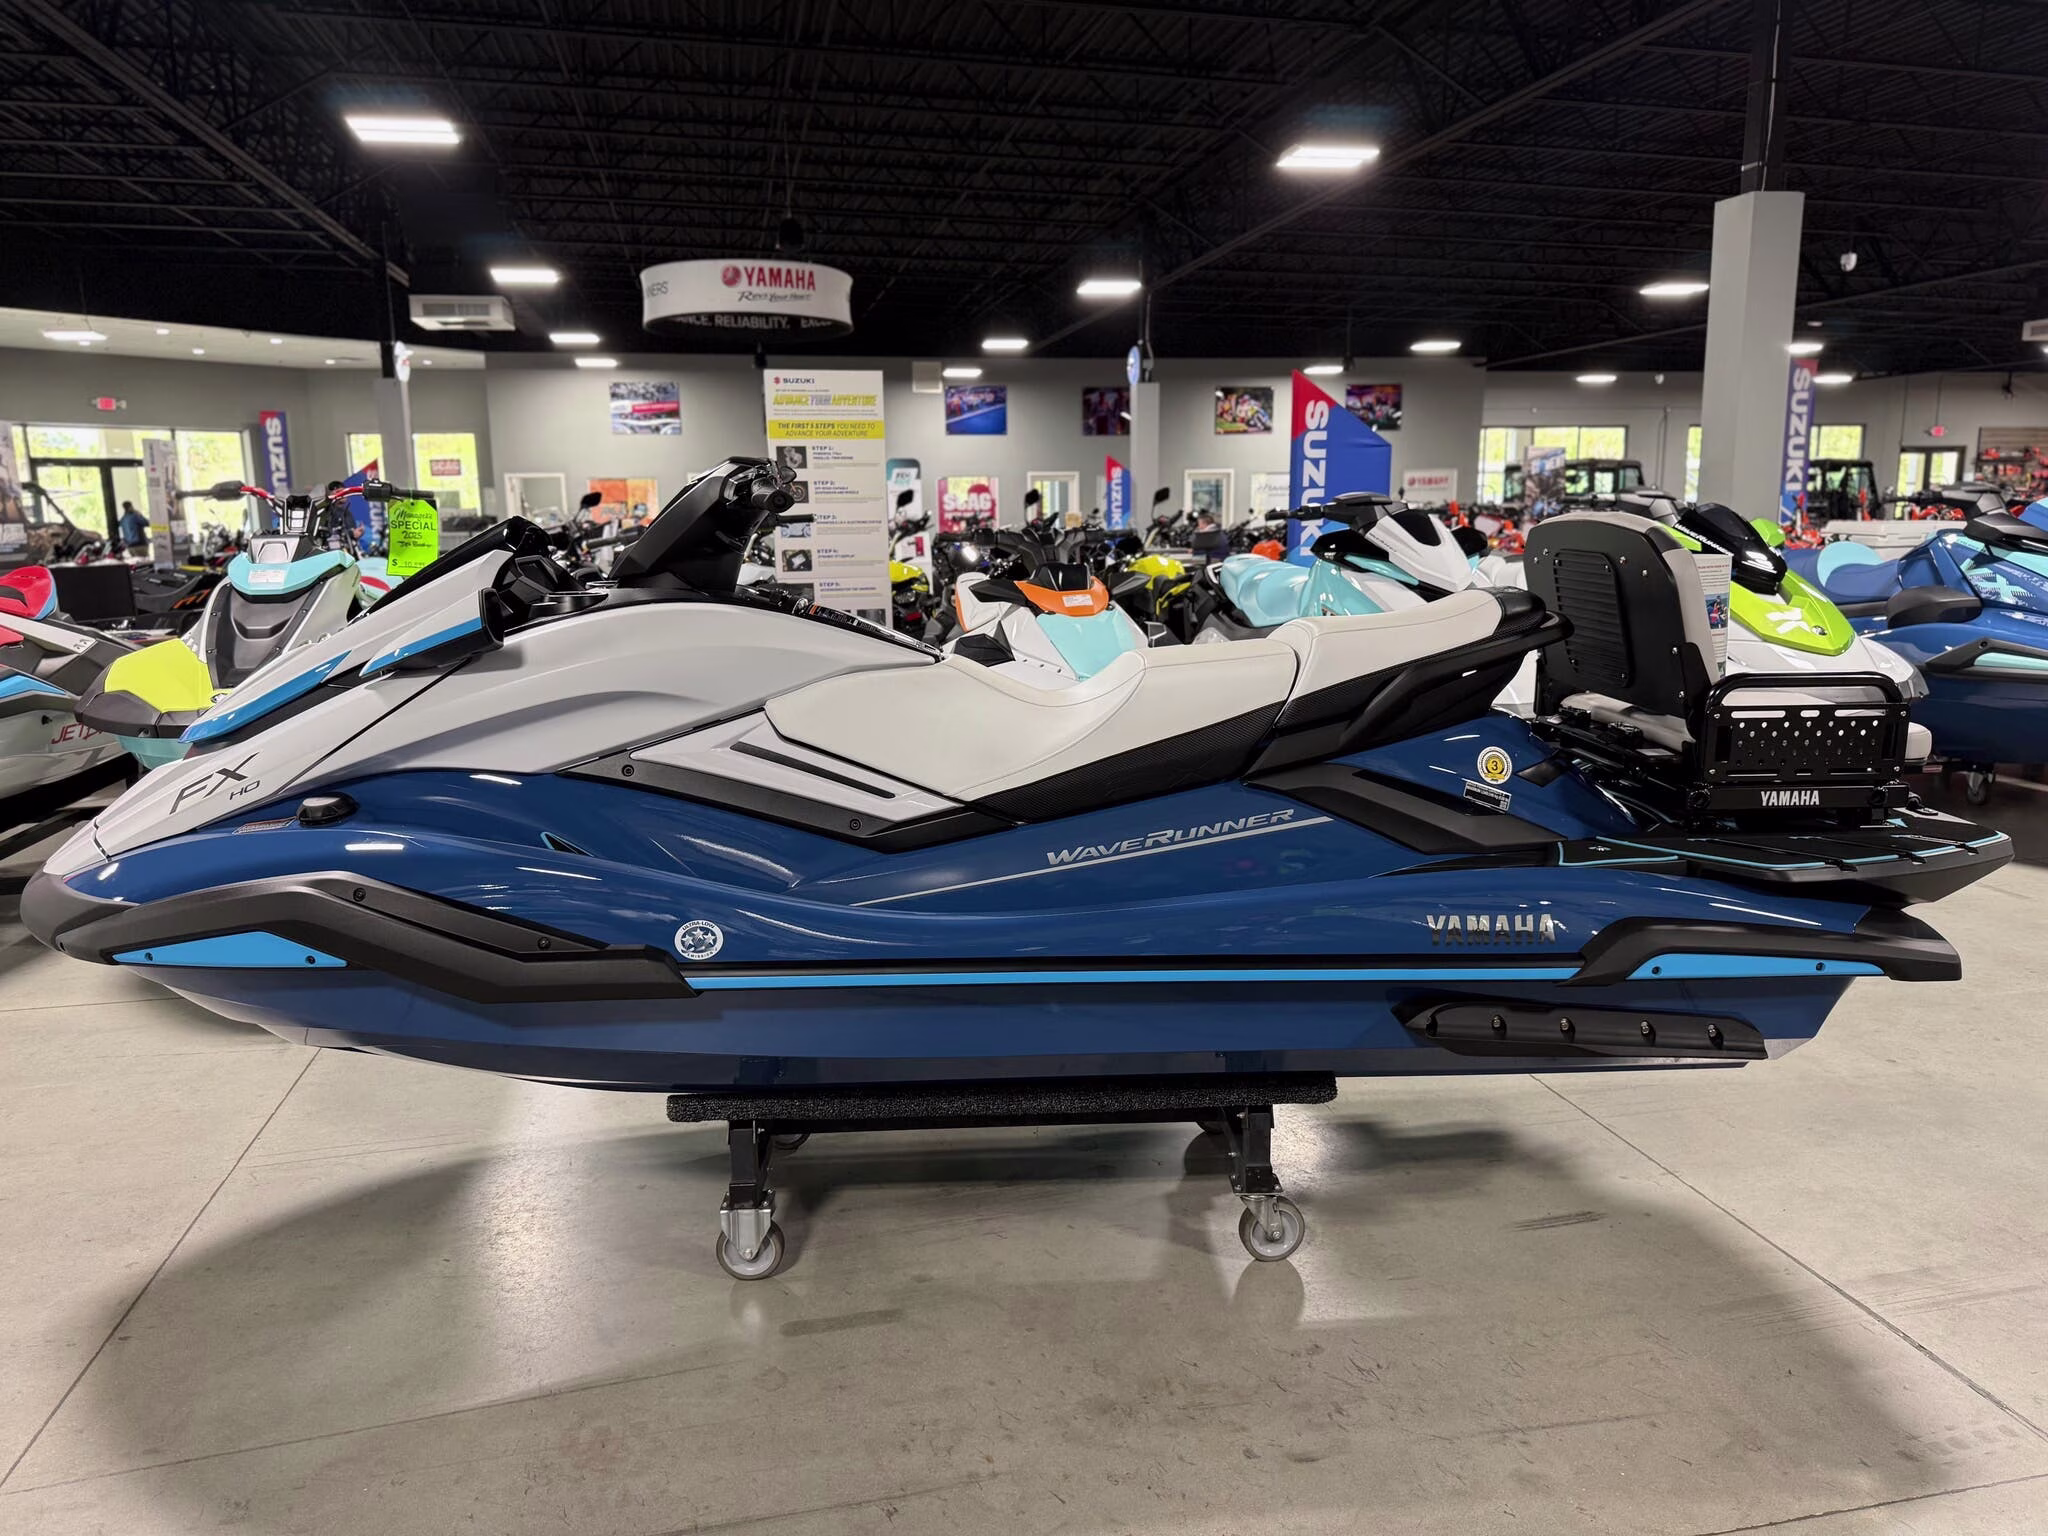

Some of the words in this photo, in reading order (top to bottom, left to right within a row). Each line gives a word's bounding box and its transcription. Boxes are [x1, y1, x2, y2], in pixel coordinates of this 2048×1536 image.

[744, 266, 816, 291] YAMAHA
[714, 314, 790, 329] RELIABILITY.
[1786, 367, 1811, 492] SUZUKI
[265, 416, 289, 489] SUZU
[1300, 399, 1330, 556] SUZUKI
[943, 492, 992, 510] SCAG
[390, 520, 437, 531] SPECIAL
[1491, 760, 1498, 771] 3
[169, 751, 260, 815] FX
[229, 780, 260, 800] HO
[1760, 790, 1820, 806] YAMAHA
[1426, 913, 1556, 945] YAMAHA
